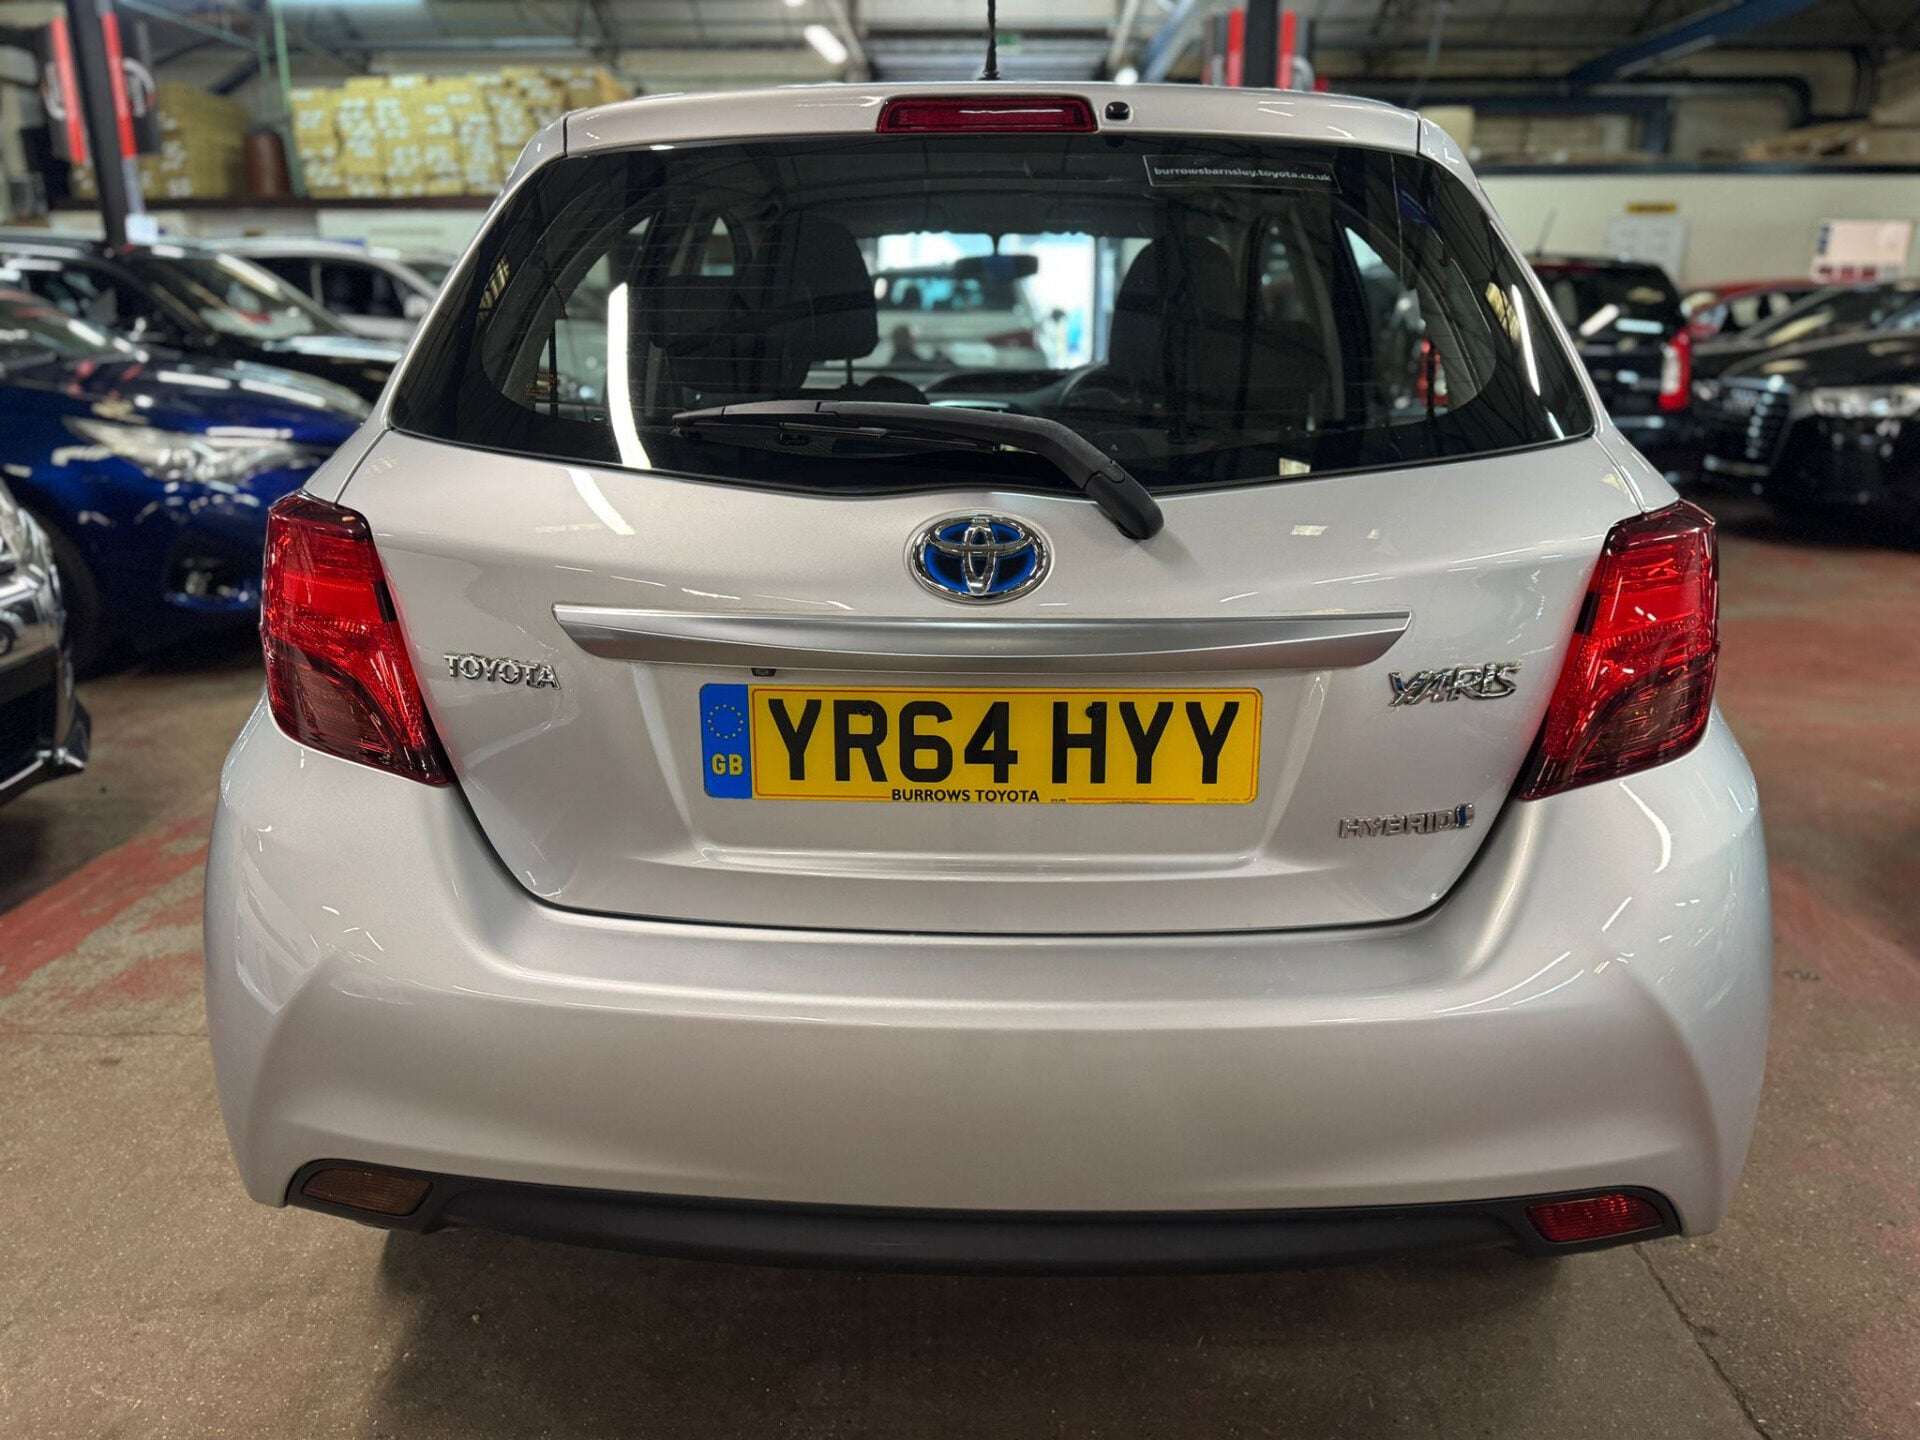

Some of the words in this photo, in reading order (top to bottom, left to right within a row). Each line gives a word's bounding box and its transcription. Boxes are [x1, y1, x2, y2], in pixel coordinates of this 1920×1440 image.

[1153, 166, 1332, 182] burrowsbarnsley.toyota.co.uk
[443, 653, 560, 690] TOYOTA
[1389, 661, 1521, 706] YARIS
[768, 698, 1018, 784] YR64
[1051, 701, 1240, 784] HYY
[711, 752, 743, 776] GB
[891, 788, 970, 802] BURROWS
[975, 789, 1039, 803] TOYOTA
[1338, 809, 1456, 840] HYBRID
